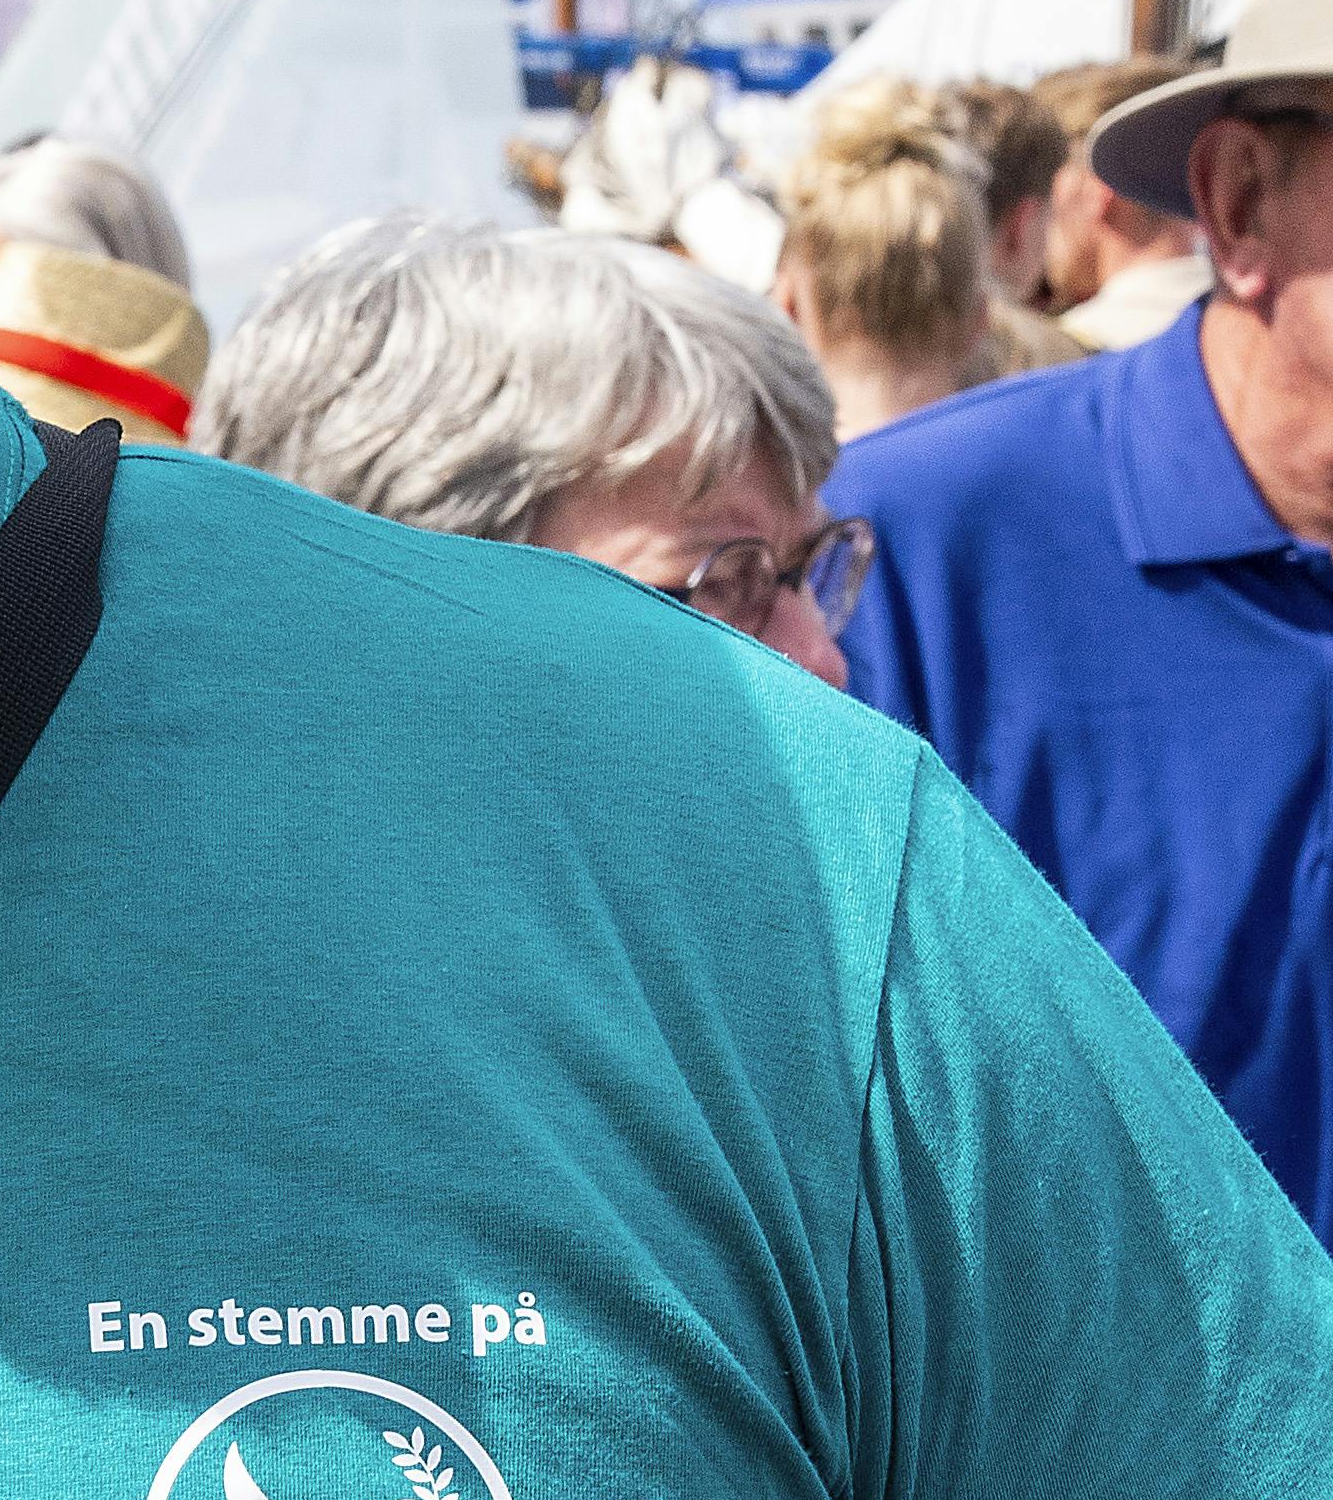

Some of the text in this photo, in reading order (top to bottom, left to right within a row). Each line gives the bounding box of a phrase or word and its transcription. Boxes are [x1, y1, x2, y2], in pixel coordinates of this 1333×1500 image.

[88, 1291, 547, 1357] En stemme på
